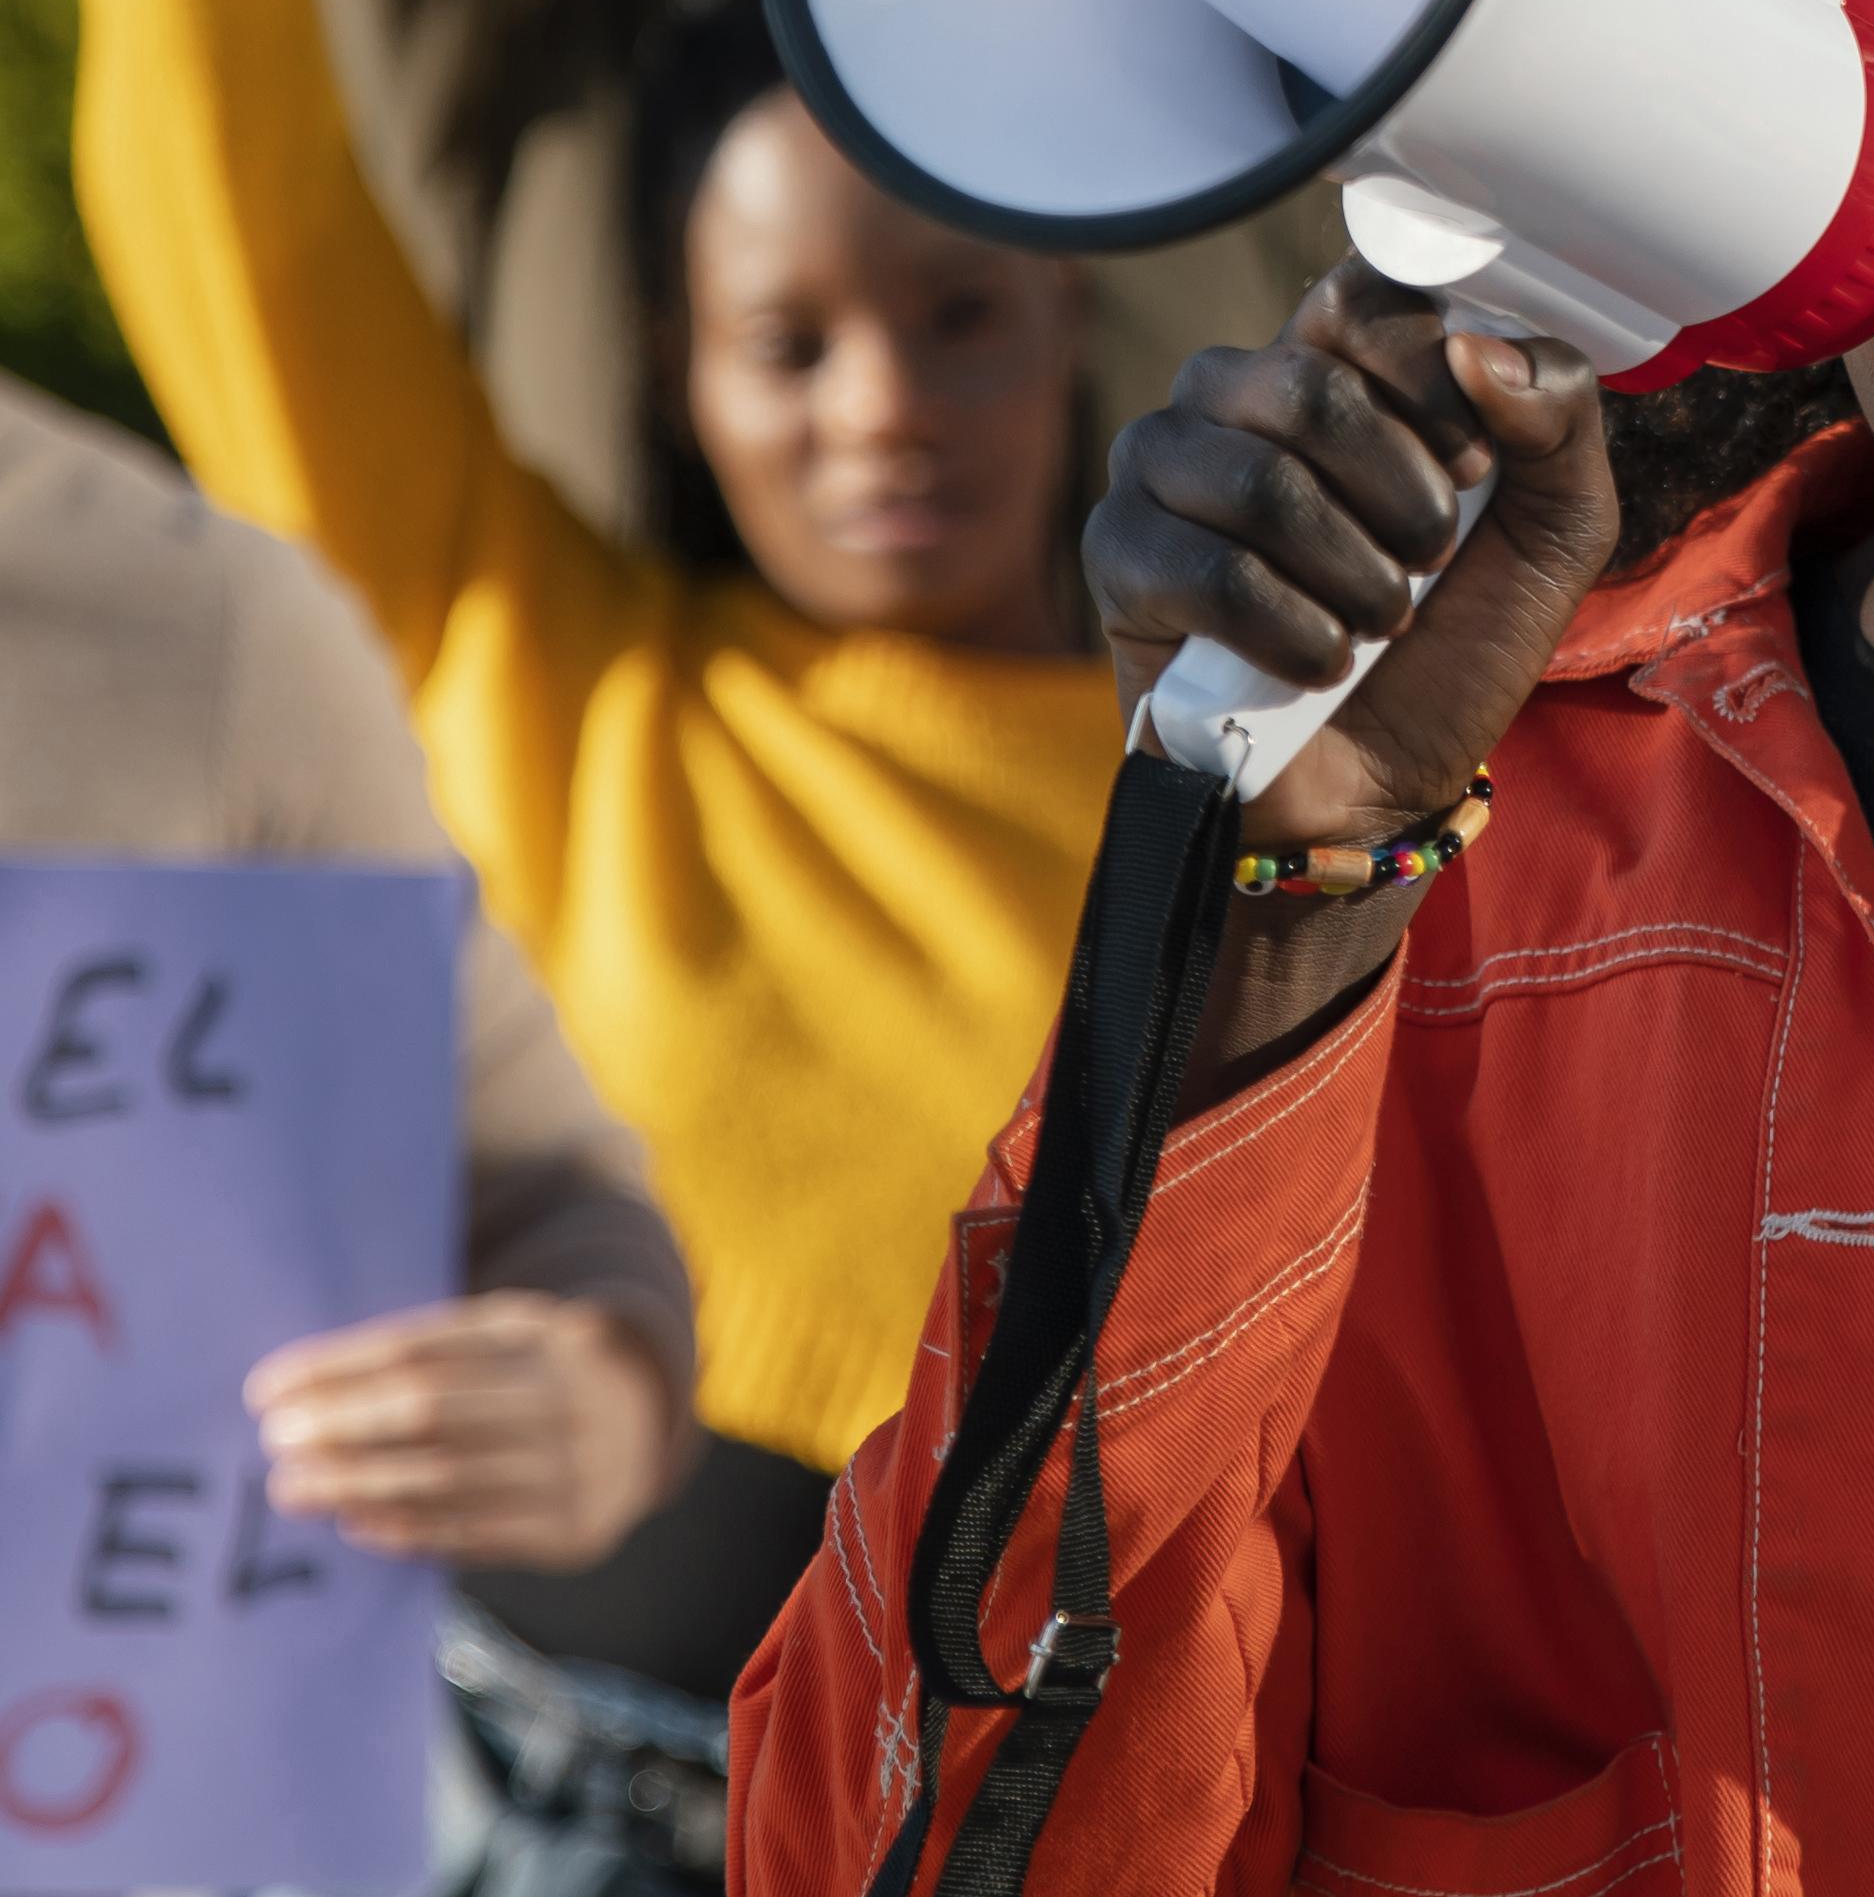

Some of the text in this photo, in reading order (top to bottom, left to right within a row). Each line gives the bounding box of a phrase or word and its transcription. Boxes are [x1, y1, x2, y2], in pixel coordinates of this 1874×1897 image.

[22, 946, 250, 1130] EL
[0, 1198, 128, 1362] A
[78, 1460, 324, 1628] EL
